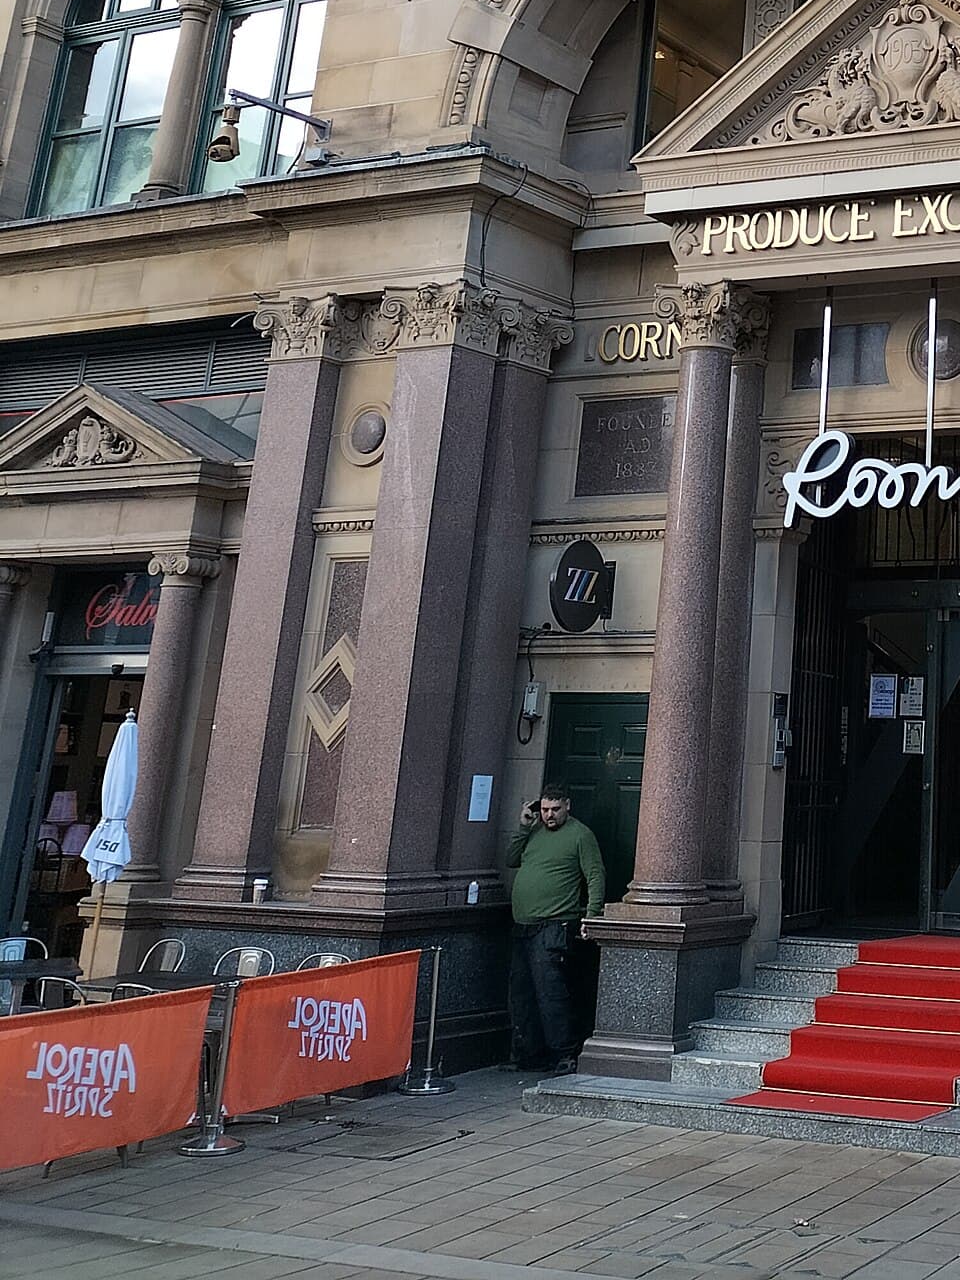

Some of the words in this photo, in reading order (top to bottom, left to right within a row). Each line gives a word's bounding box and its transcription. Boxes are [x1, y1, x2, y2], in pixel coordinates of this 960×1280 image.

[888, 38, 925, 70] 1903
[701, 200, 876, 256] PRODUCE
[596, 412, 672, 433] FOUNDE
[615, 460, 657, 479] 1837
[86, 584, 160, 640] Salv
